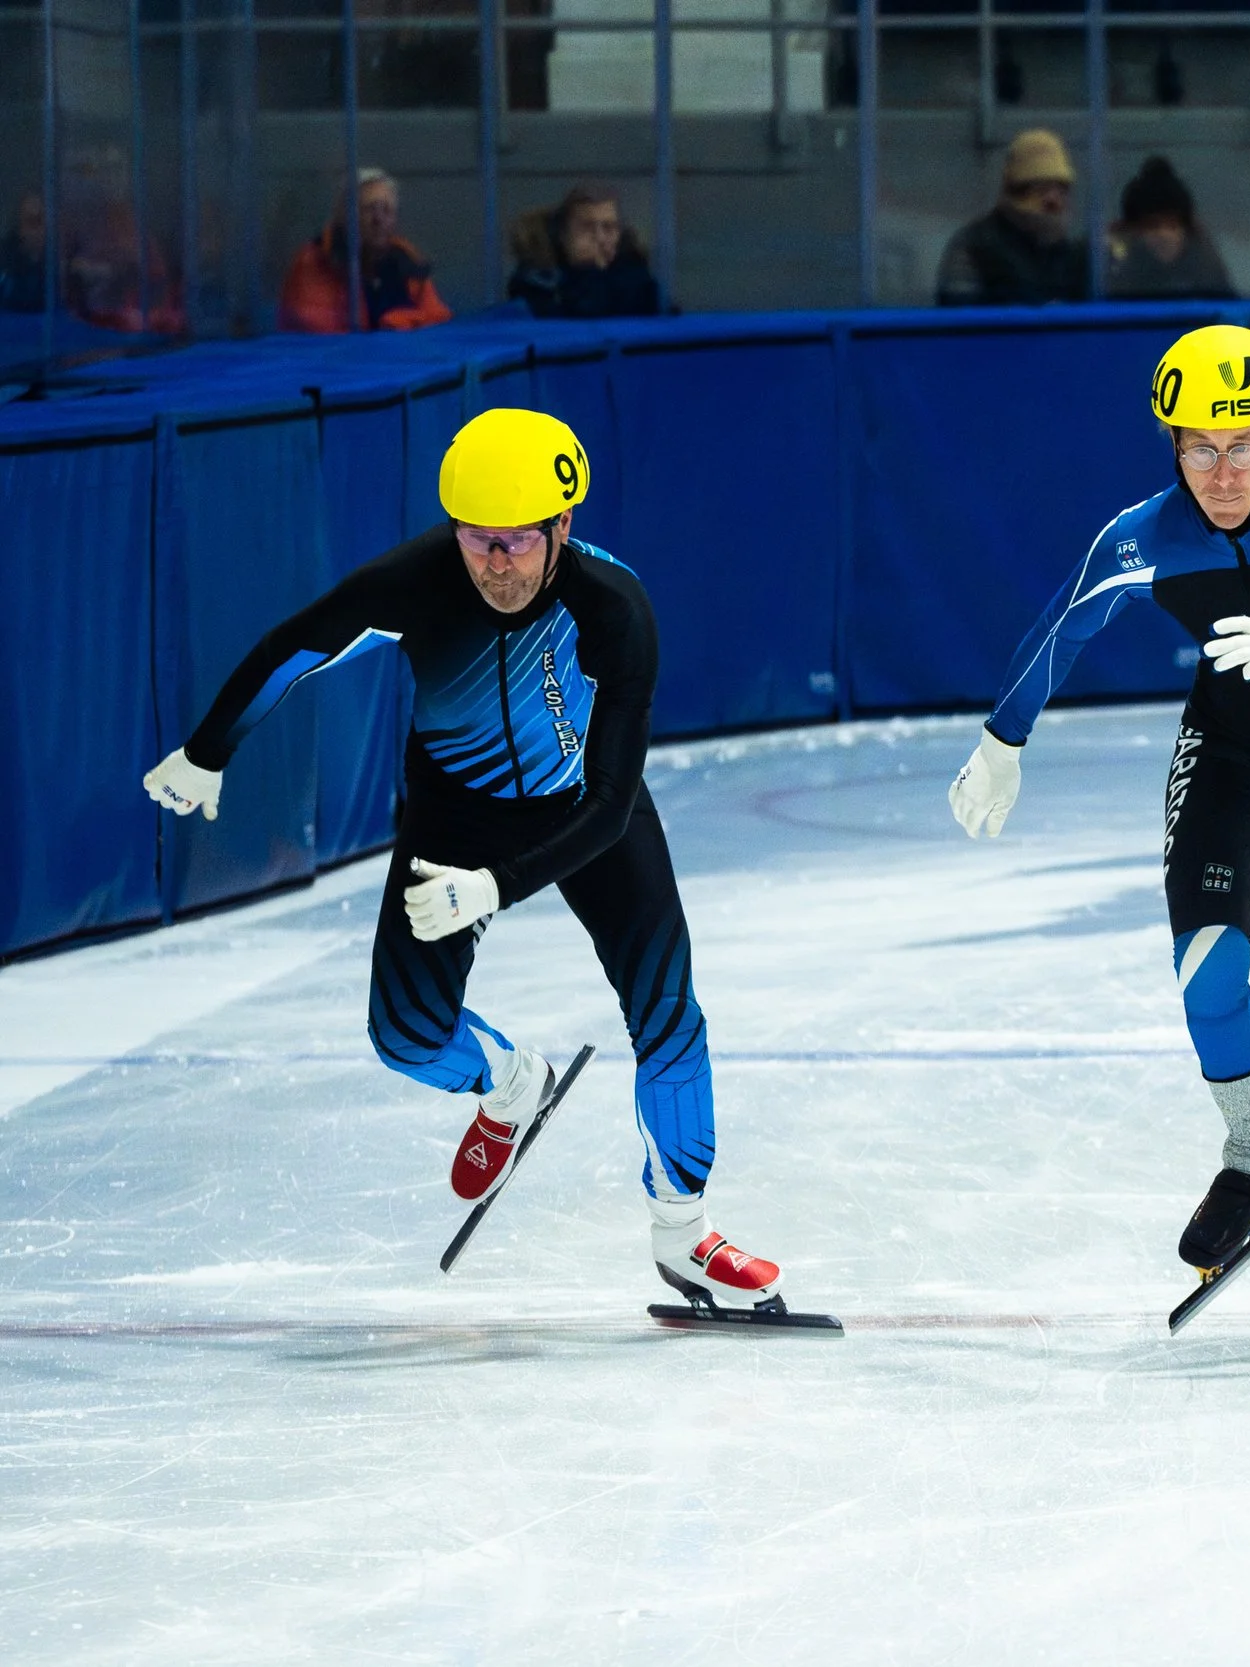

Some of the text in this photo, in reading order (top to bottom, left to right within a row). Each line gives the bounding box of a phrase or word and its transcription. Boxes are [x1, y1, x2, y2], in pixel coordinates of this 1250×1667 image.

[1118, 543, 1136, 555] APO
[1122, 557, 1142, 569] GEE
[543, 651, 580, 757] EAST PENN
[1207, 865, 1232, 877] APO
[1205, 879, 1229, 890] GEE
